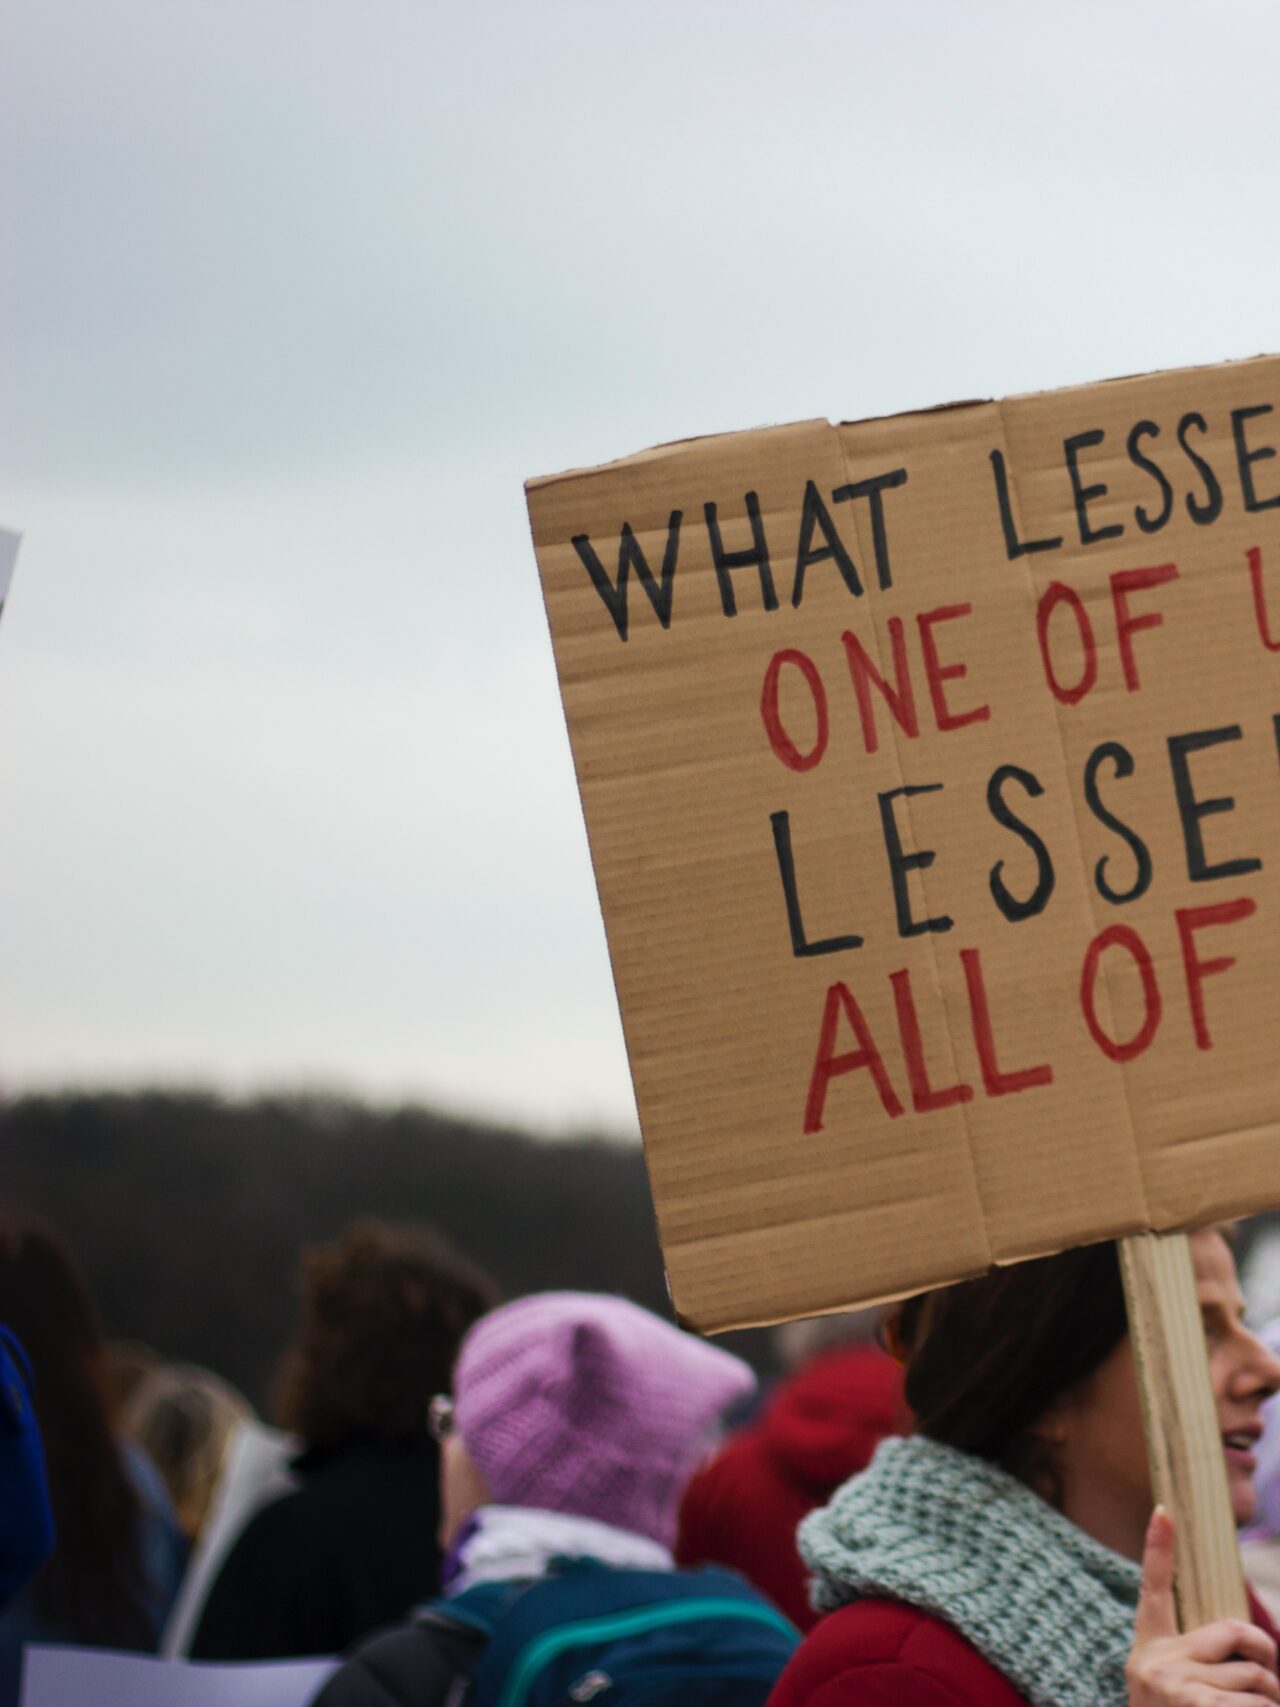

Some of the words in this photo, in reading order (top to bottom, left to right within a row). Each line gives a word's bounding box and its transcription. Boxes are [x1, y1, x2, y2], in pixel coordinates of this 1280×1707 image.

[571, 469, 907, 641] WHAT
[760, 604, 990, 772] ONE
[1036, 564, 1180, 705] OF
[803, 948, 1053, 1134] ALL
[1080, 897, 1256, 1061] OF
